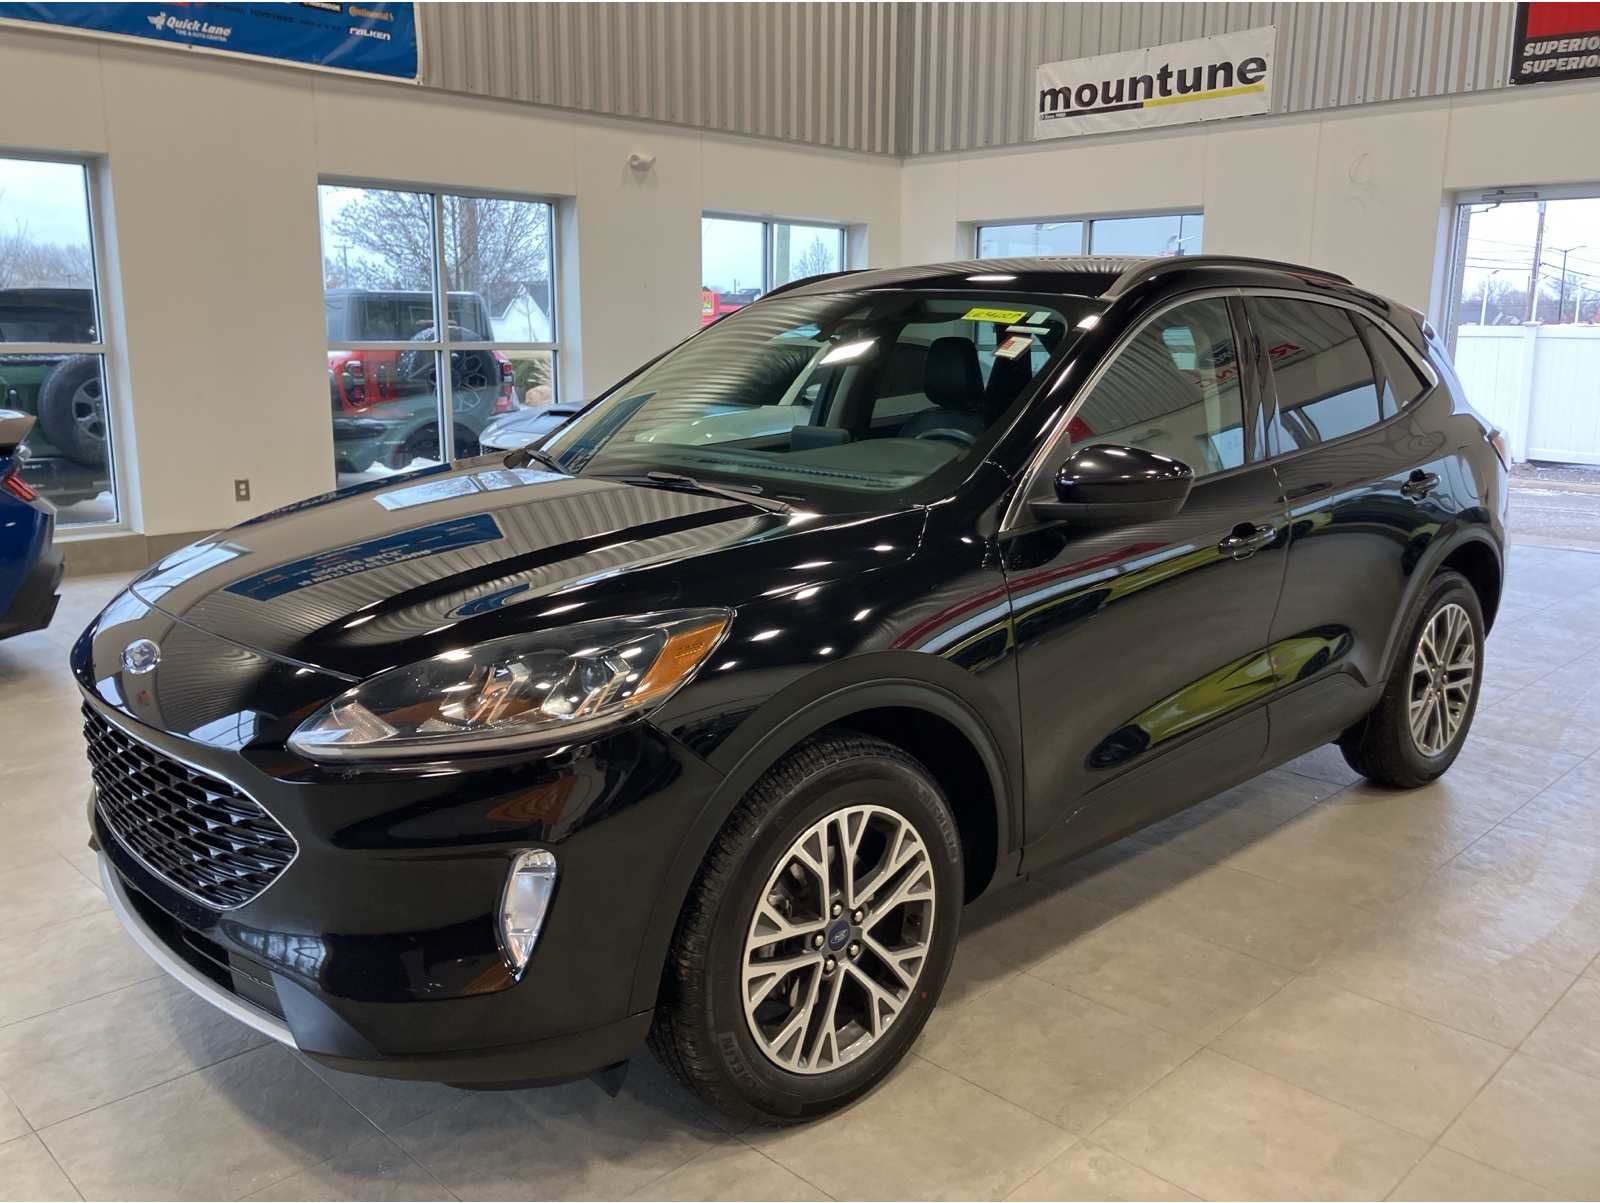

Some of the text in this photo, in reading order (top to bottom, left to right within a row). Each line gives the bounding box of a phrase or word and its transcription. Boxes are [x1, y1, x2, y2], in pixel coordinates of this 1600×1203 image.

[166, 16, 233, 37] Quick Lane
[349, 27, 391, 40] FALKEN
[1523, 36, 1600, 57] SUPERIO
[1521, 54, 1600, 75] SUPERIO
[1039, 56, 1267, 113] mountune
